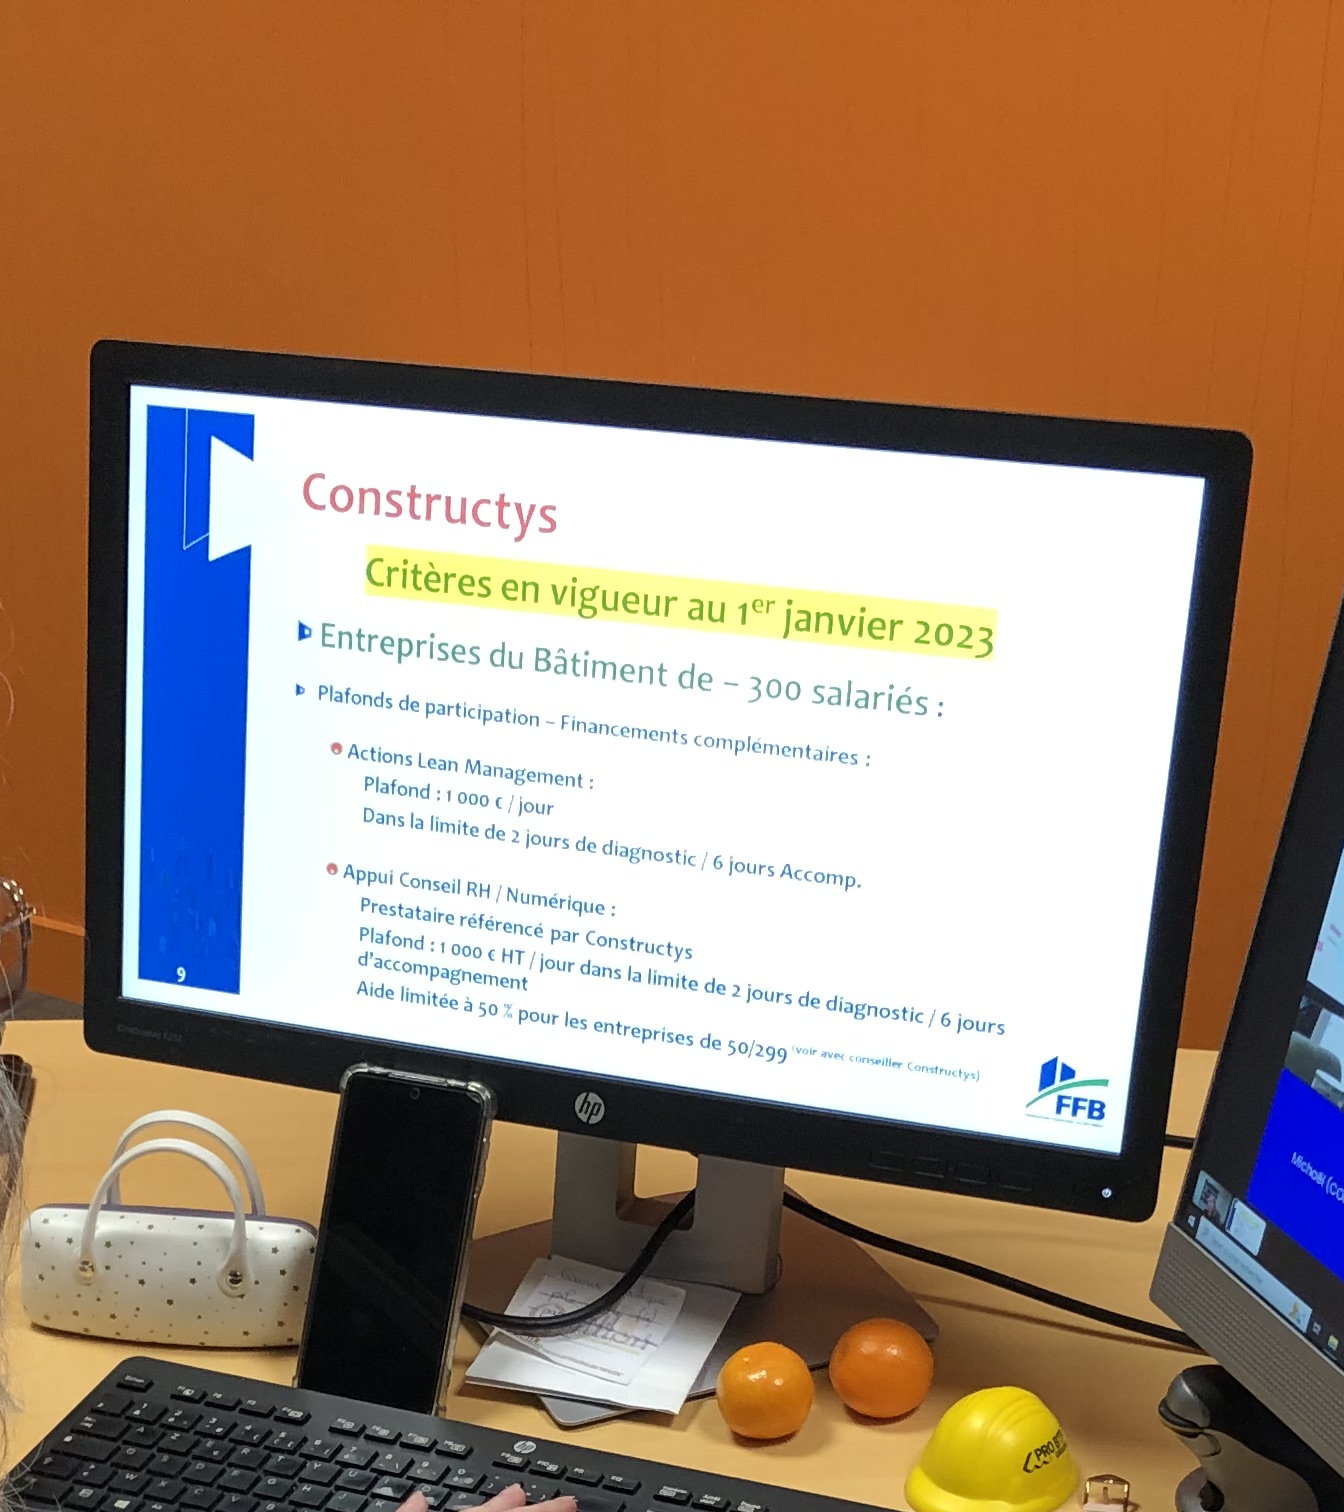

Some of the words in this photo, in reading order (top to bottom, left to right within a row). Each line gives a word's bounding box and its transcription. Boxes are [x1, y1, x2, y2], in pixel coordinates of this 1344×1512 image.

[303, 472, 557, 543] Constructys
[365, 557, 492, 598] Critères
[501, 578, 540, 603] en
[551, 576, 678, 620] vigueur
[687, 598, 726, 624] au
[782, 598, 904, 642] janvier
[913, 620, 994, 659] 2023
[320, 622, 482, 664] Entreprises
[489, 641, 524, 670] du
[534, 646, 668, 688] Bâtiment
[677, 662, 714, 692] de
[747, 676, 802, 704] 300
[811, 679, 929, 717] salariés
[318, 684, 393, 710] Plafonds
[398, 694, 420, 713] de
[425, 702, 540, 728] participation
[560, 714, 688, 746] Financements
[693, 735, 858, 766] complémentaires
[347, 743, 413, 767] Actions
[417, 752, 459, 773] Lean
[464, 758, 584, 789] Management
[363, 776, 431, 801] Plafond
[445, 789, 452, 804] 1
[457, 791, 490, 808] 000
[517, 796, 554, 817] jour
[362, 806, 406, 829] Dans
[410, 812, 424, 831] la
[430, 814, 480, 838] limite
[484, 824, 506, 842] de
[511, 830, 521, 844] 2
[525, 828, 570, 850] jours
[575, 836, 597, 854] de
[601, 839, 697, 867] diagnostic
[712, 855, 724, 870] 6
[728, 855, 775, 877] jours
[779, 863, 862, 893] Accomp.
[342, 863, 394, 887] Appui
[399, 871, 461, 896] Conseil
[466, 881, 491, 900] RH
[506, 886, 606, 917] Numérique
[360, 896, 455, 926] Prestataire
[459, 911, 544, 939] référencé
[550, 926, 579, 945] par
[585, 929, 693, 963] Constructys
[176, 966, 187, 983] 9
[359, 926, 425, 951] Plafond
[439, 940, 446, 955] 1
[451, 943, 483, 959] 000
[501, 947, 525, 966] HT
[539, 952, 576, 973] jour
[580, 959, 622, 980] dans
[627, 964, 642, 984] la
[647, 968, 699, 992] limite
[704, 977, 727, 996] de
[731, 984, 741, 998] 2
[746, 983, 793, 1006] jours
[798, 990, 821, 1010] de
[826, 995, 924, 1024] diagnostic
[940, 1012, 951, 1027] 6
[956, 1012, 1006, 1036] jours
[357, 980, 395, 1001] Aide
[400, 985, 459, 1010] limitée
[463, 996, 473, 1012] à
[478, 1001, 498, 1018] 50
[518, 1007, 559, 1025] pour
[564, 1011, 588, 1030] les
[593, 1019, 694, 1047] entreprises
[700, 1033, 722, 1051] de
[727, 1039, 788, 1064] 50/299
[820, 1050, 845, 1062] avec
[849, 1053, 903, 1070] conseiller
[575, 1091, 605, 1125] hp
[1056, 1094, 1107, 1122] FFB
